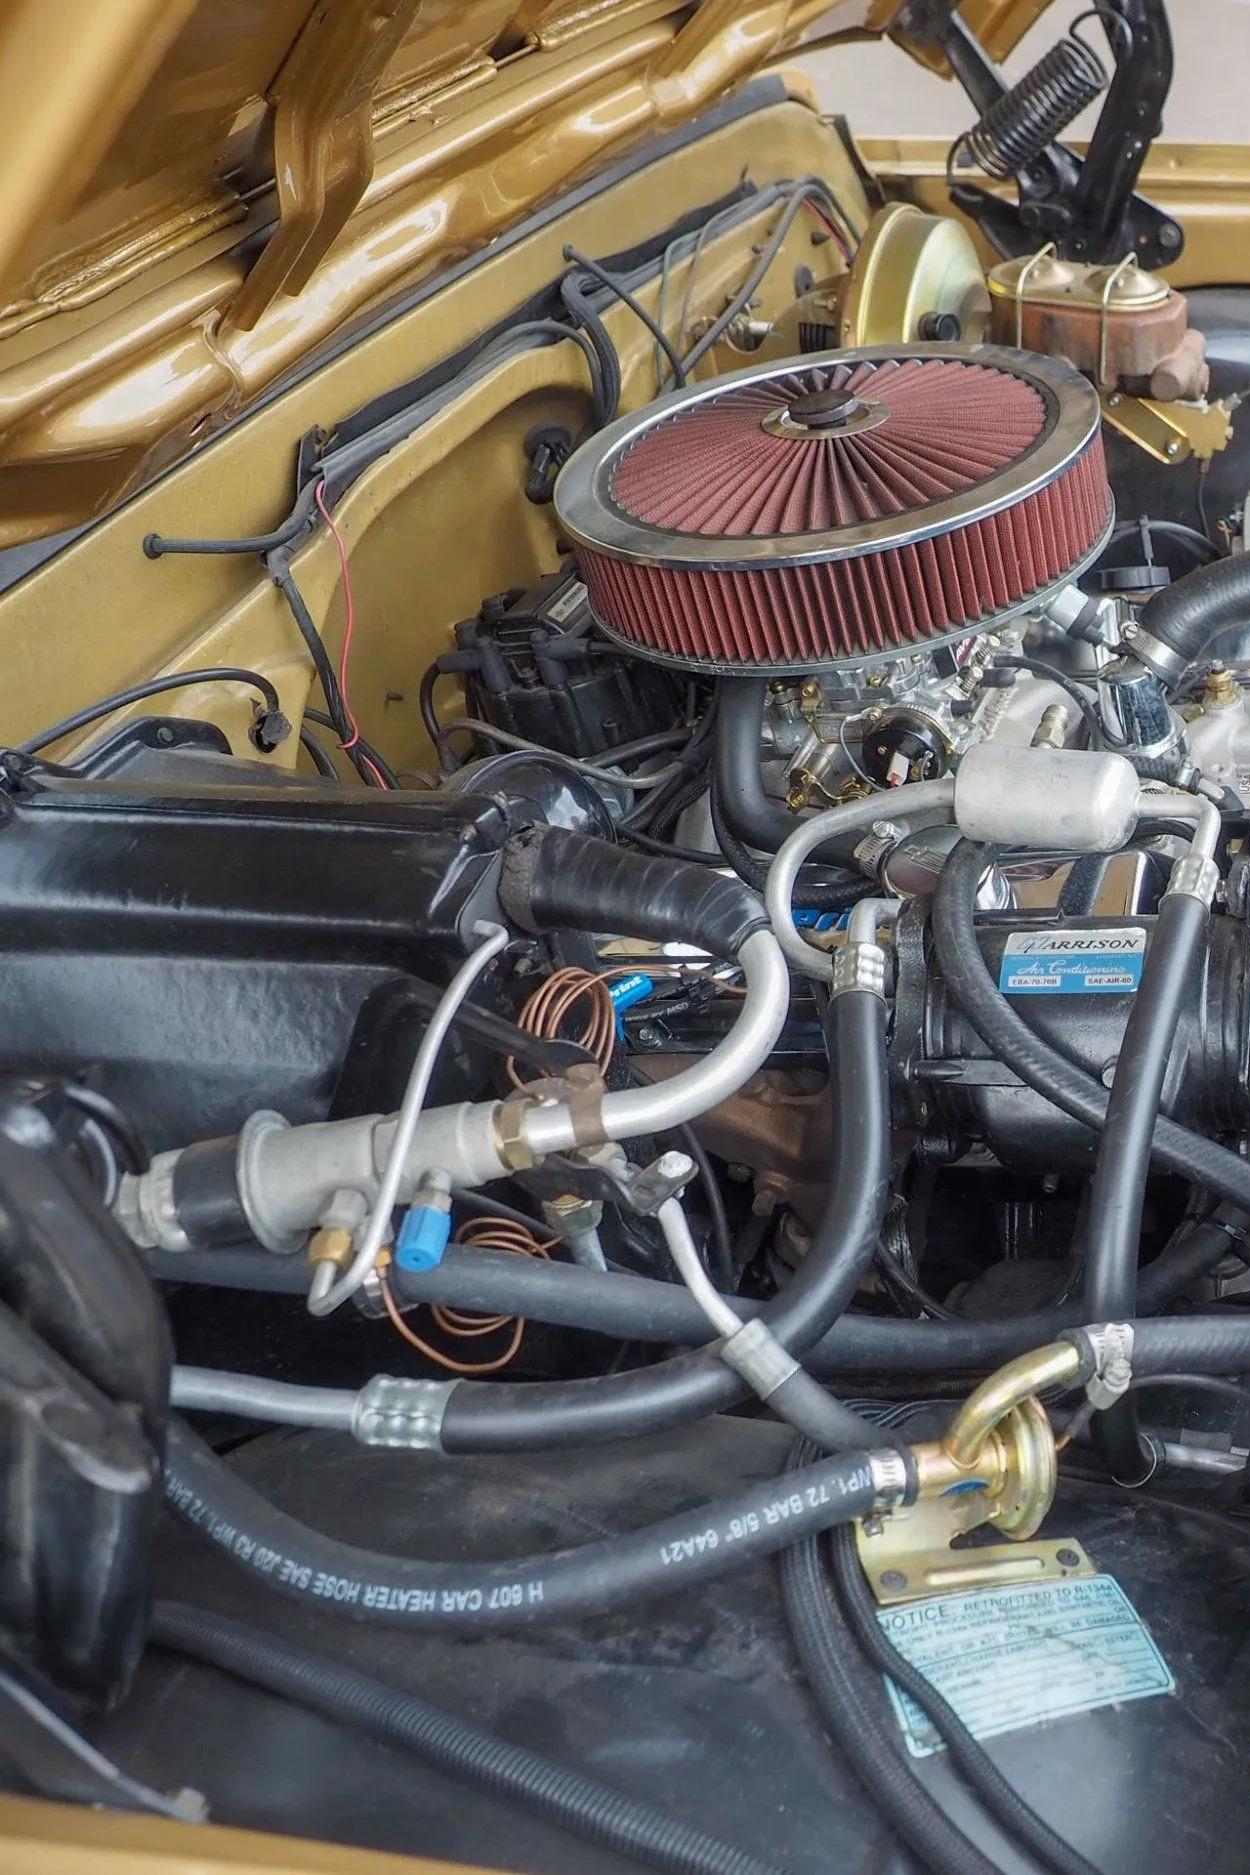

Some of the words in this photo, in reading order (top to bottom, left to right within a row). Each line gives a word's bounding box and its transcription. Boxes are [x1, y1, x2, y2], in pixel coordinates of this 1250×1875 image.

[1017, 936, 1139, 953] HARRISON
[1017, 960, 1045, 975] Air
[1047, 960, 1126, 975] Conditioning
[666, 1001, 689, 1015] MSD
[806, 1484, 830, 1507] 72
[762, 1494, 804, 1525] BAR
[660, 1528, 719, 1565] 64A21
[279, 1557, 313, 1590] SAE
[312, 1572, 362, 1602] HOSE
[363, 1585, 435, 1612] HEATER
[488, 1583, 523, 1609] 607
[528, 1581, 544, 1605] H
[1055, 1587, 1072, 1598] TO
[441, 1588, 482, 1612] CAR
